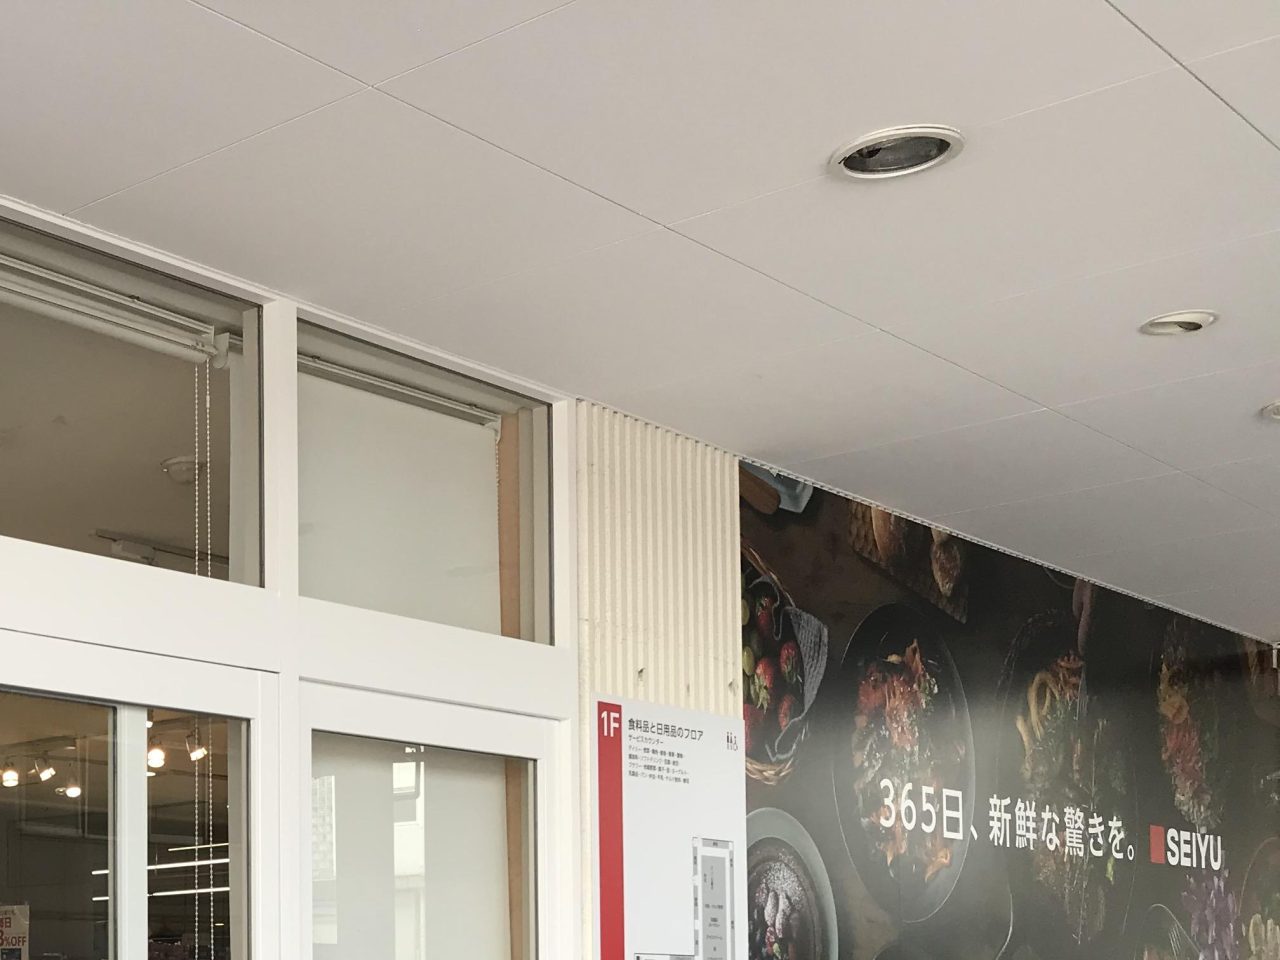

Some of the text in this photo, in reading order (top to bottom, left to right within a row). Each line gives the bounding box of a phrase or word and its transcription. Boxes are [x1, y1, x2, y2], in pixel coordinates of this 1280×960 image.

[601, 710, 620, 738] 1F
[628, 718, 704, 742] 食料品と日用品のフロア
[1166, 827, 1222, 871] SEIYU
